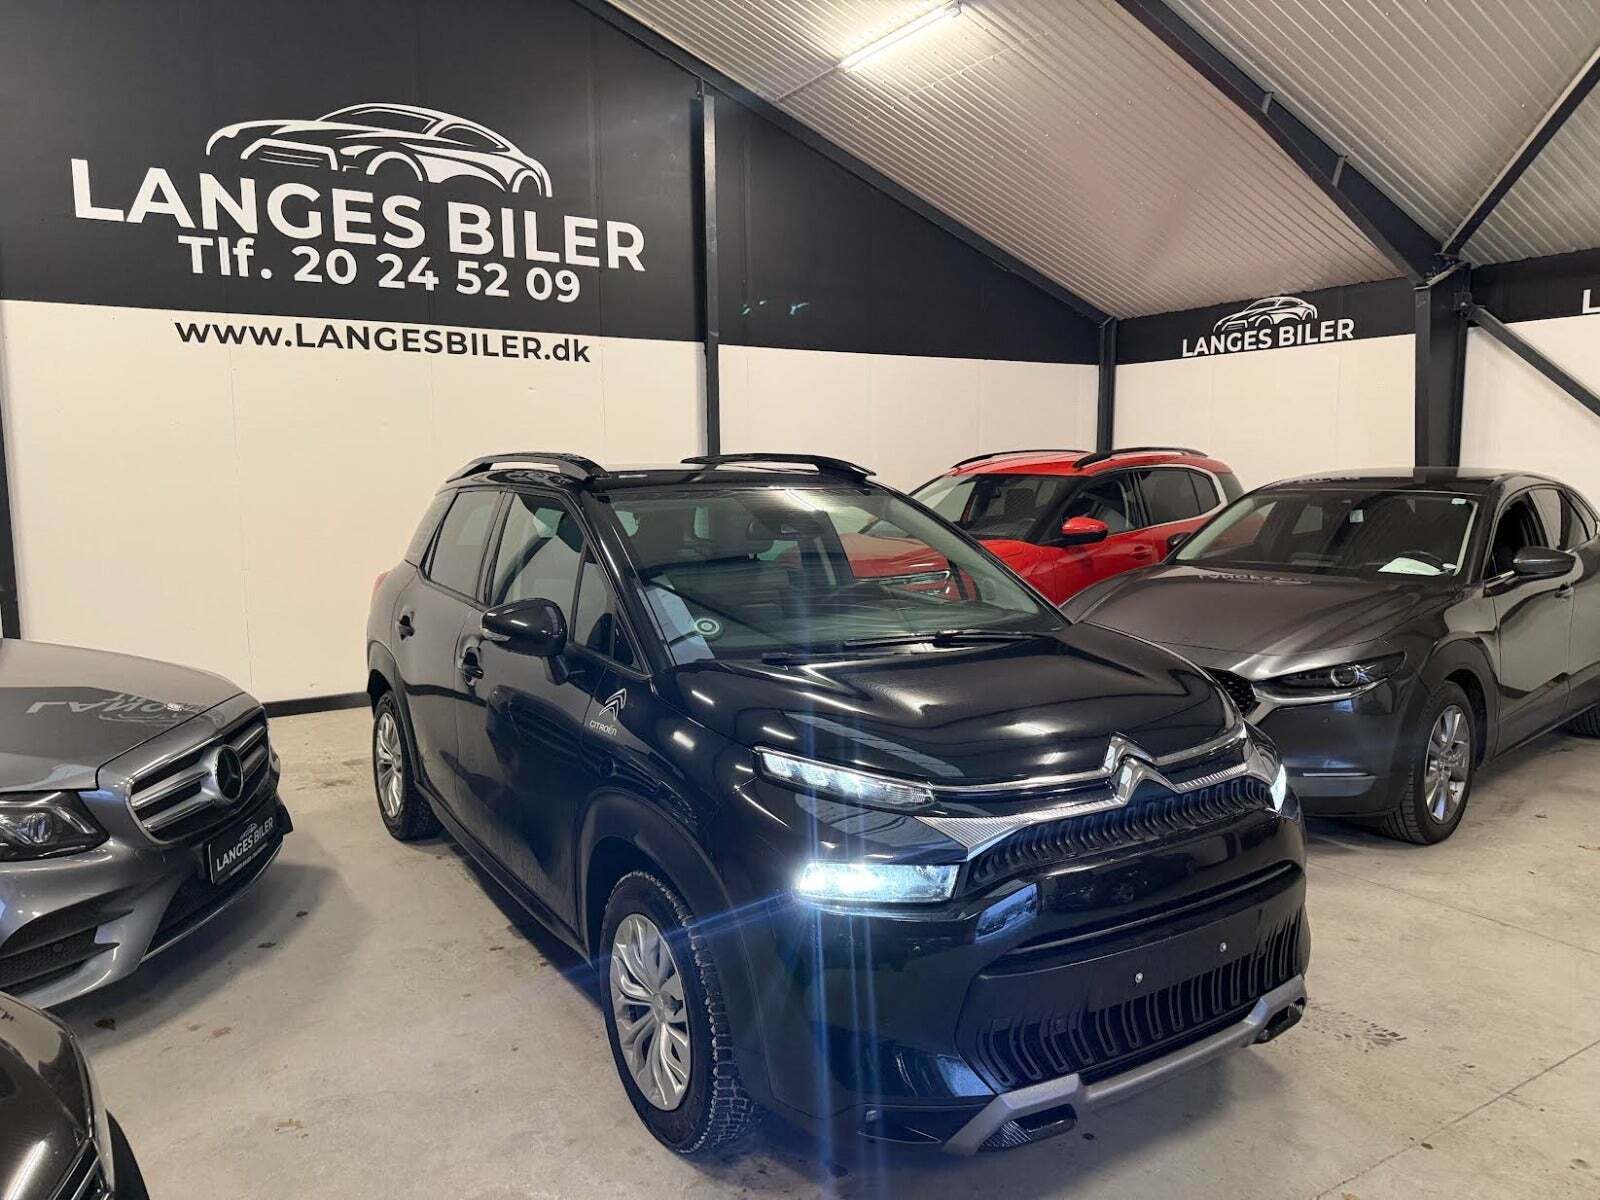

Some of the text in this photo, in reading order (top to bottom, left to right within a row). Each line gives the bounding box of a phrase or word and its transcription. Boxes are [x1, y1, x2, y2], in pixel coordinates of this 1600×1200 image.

[71, 158, 646, 272] LANGES BILER
[177, 234, 581, 303] Tlf. 20 24 52 09
[175, 321, 591, 363] www.LANGESBILER.dk
[1181, 318, 1355, 358] LANGES BILER
[216, 835, 253, 872] LANGES
[253, 817, 274, 844] BILER
